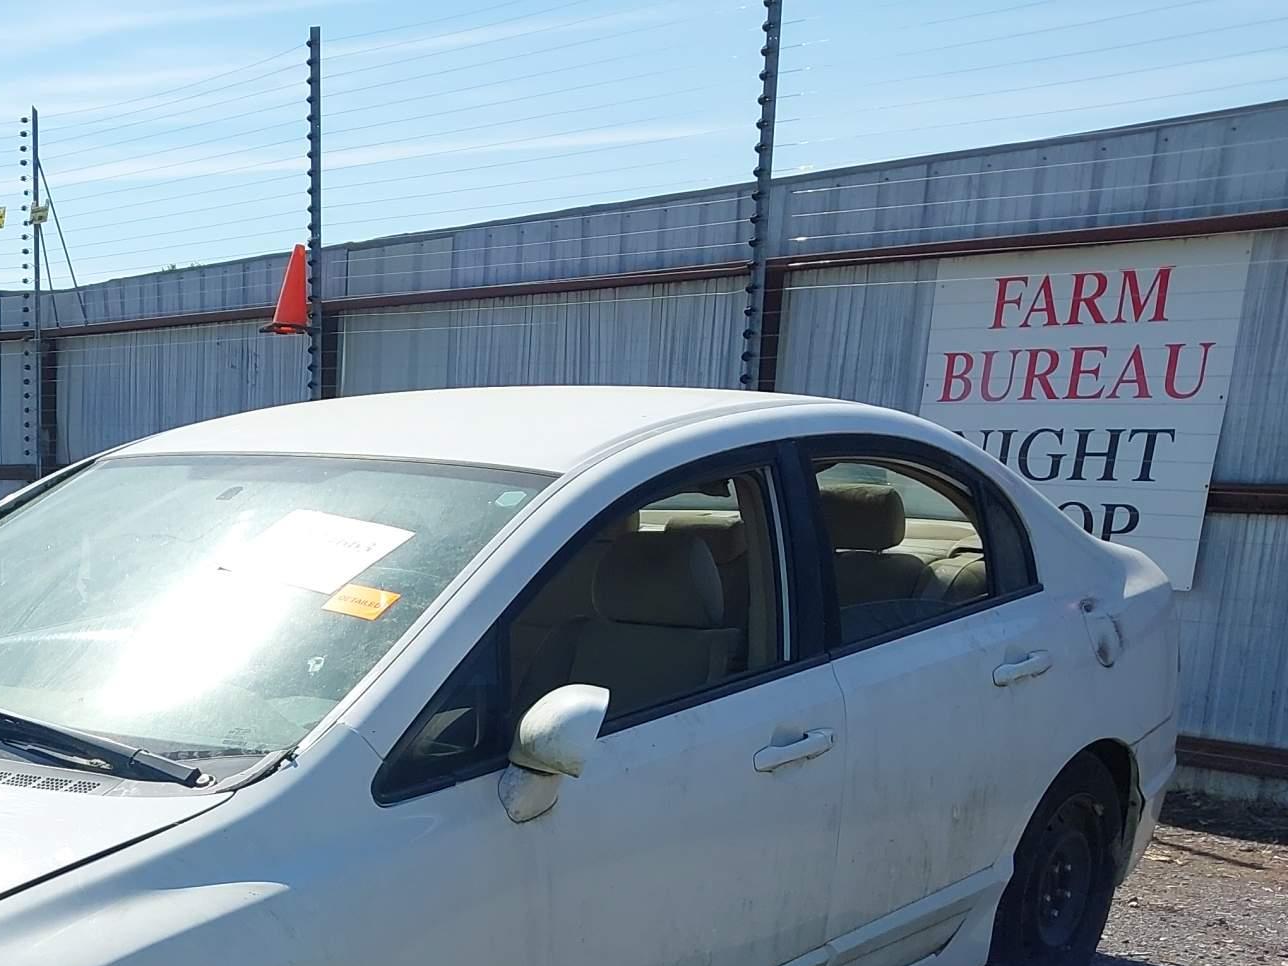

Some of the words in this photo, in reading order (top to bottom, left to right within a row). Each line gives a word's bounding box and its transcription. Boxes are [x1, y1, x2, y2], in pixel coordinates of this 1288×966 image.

[988, 265, 1176, 330] FARM
[937, 342, 1216, 403] BUREAU
[953, 428, 1176, 482] IGHT
